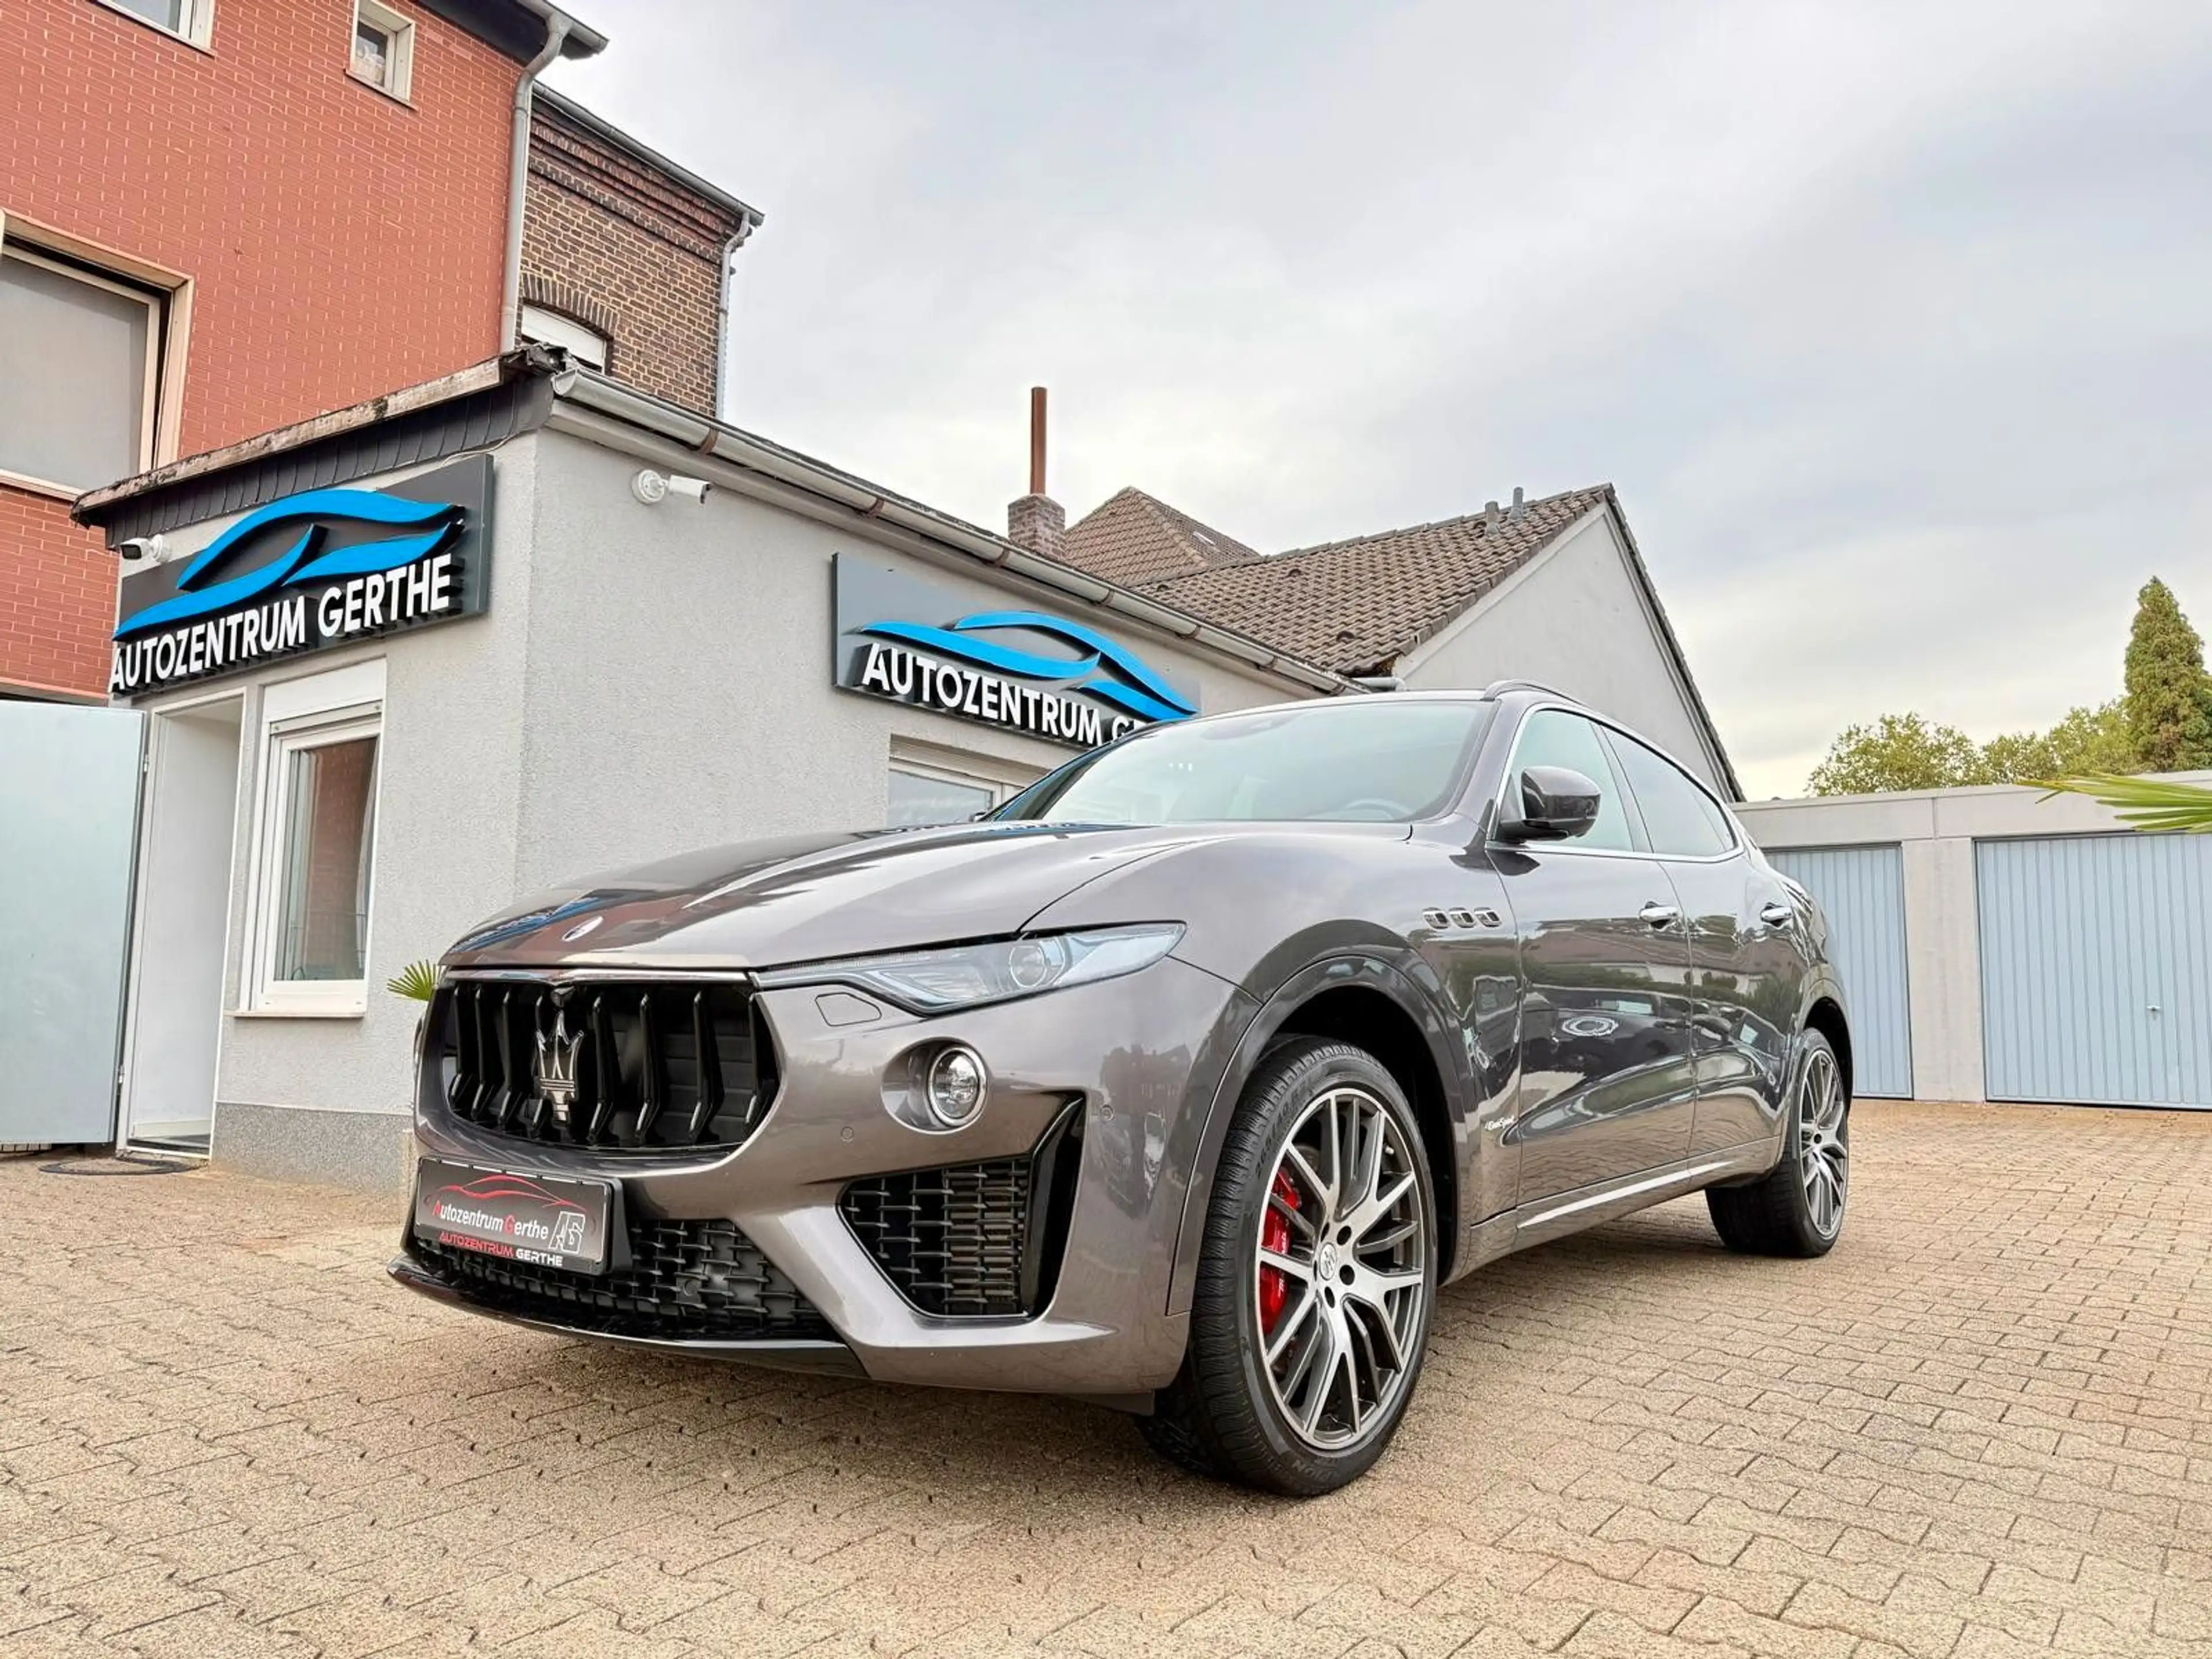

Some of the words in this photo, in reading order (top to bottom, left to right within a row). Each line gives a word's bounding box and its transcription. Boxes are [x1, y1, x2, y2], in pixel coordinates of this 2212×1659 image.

[108, 595, 306, 692] AUTOZENTRUM
[317, 554, 452, 637] GERTHE
[862, 642, 1102, 747] AUTOZENTRUM
[439, 1230, 514, 1259] AUTOZENTRUM
[516, 1248, 563, 1267] GERTHE
